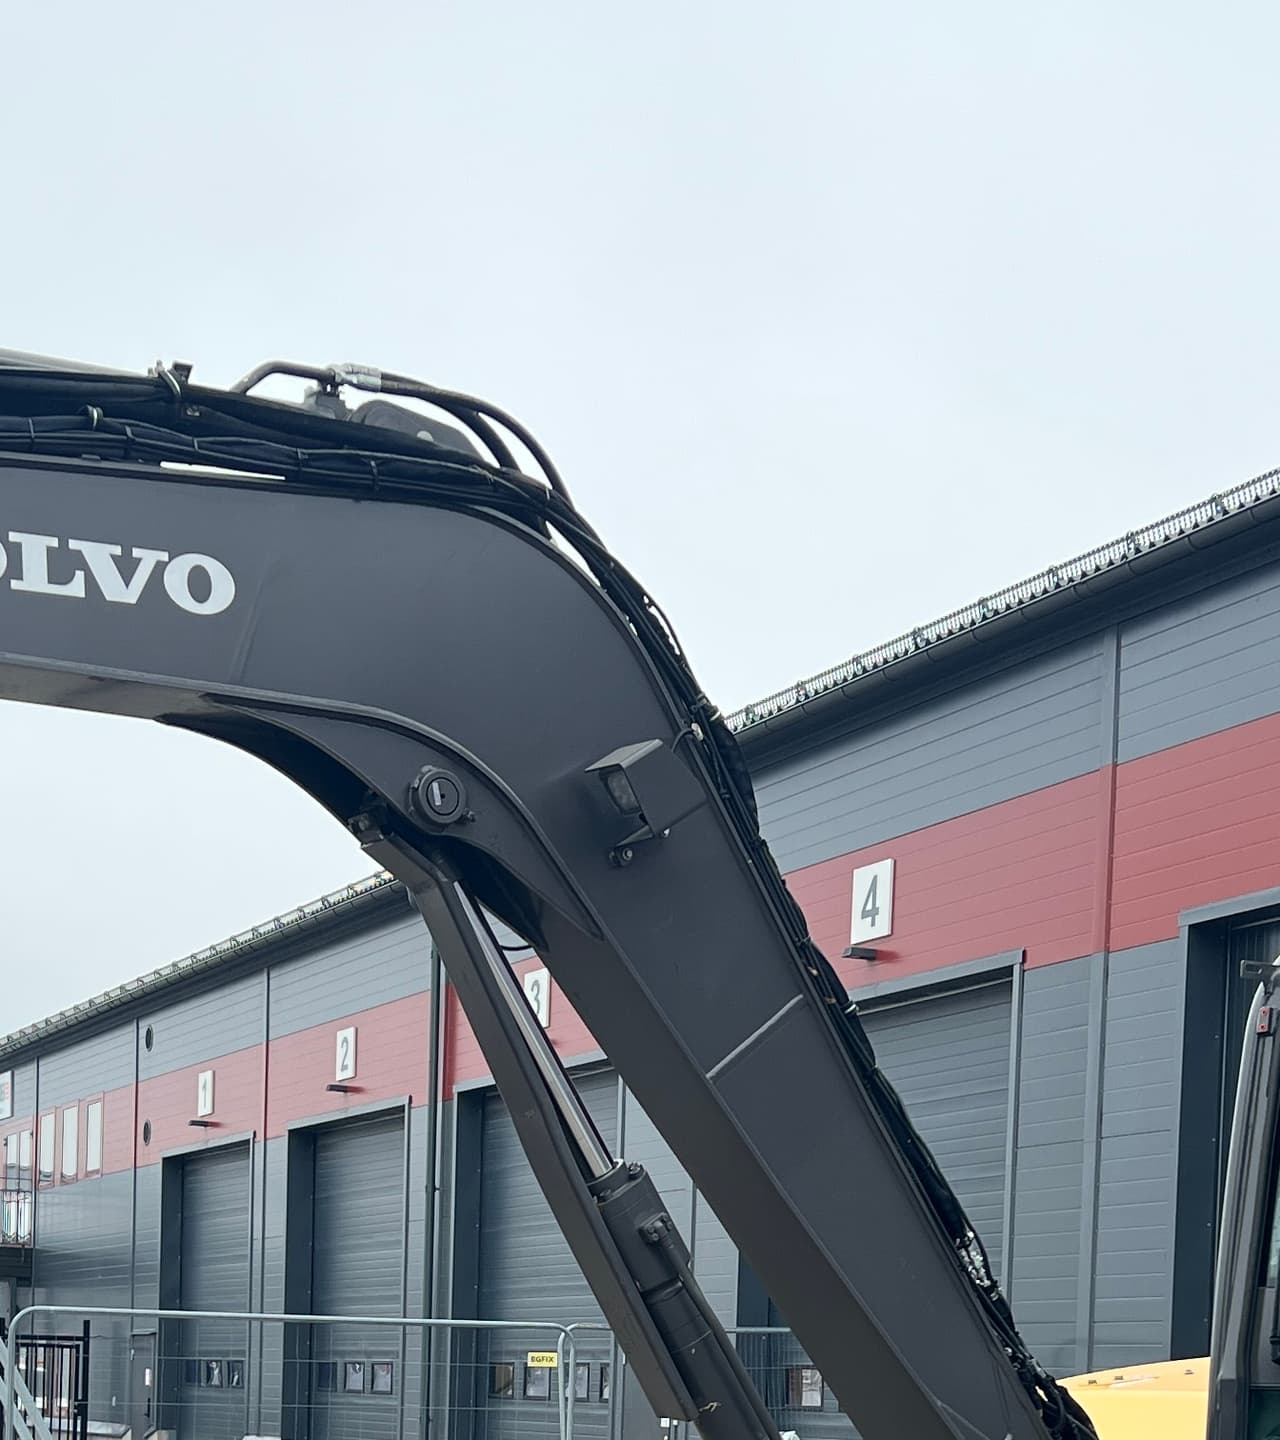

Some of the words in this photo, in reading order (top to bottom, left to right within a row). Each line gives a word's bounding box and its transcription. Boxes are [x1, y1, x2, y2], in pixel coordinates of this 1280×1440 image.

[861, 874, 879, 928] 4
[340, 1036, 349, 1072] 2
[201, 1078, 208, 1109] 1
[530, 1355, 554, 1363] BGFIX
